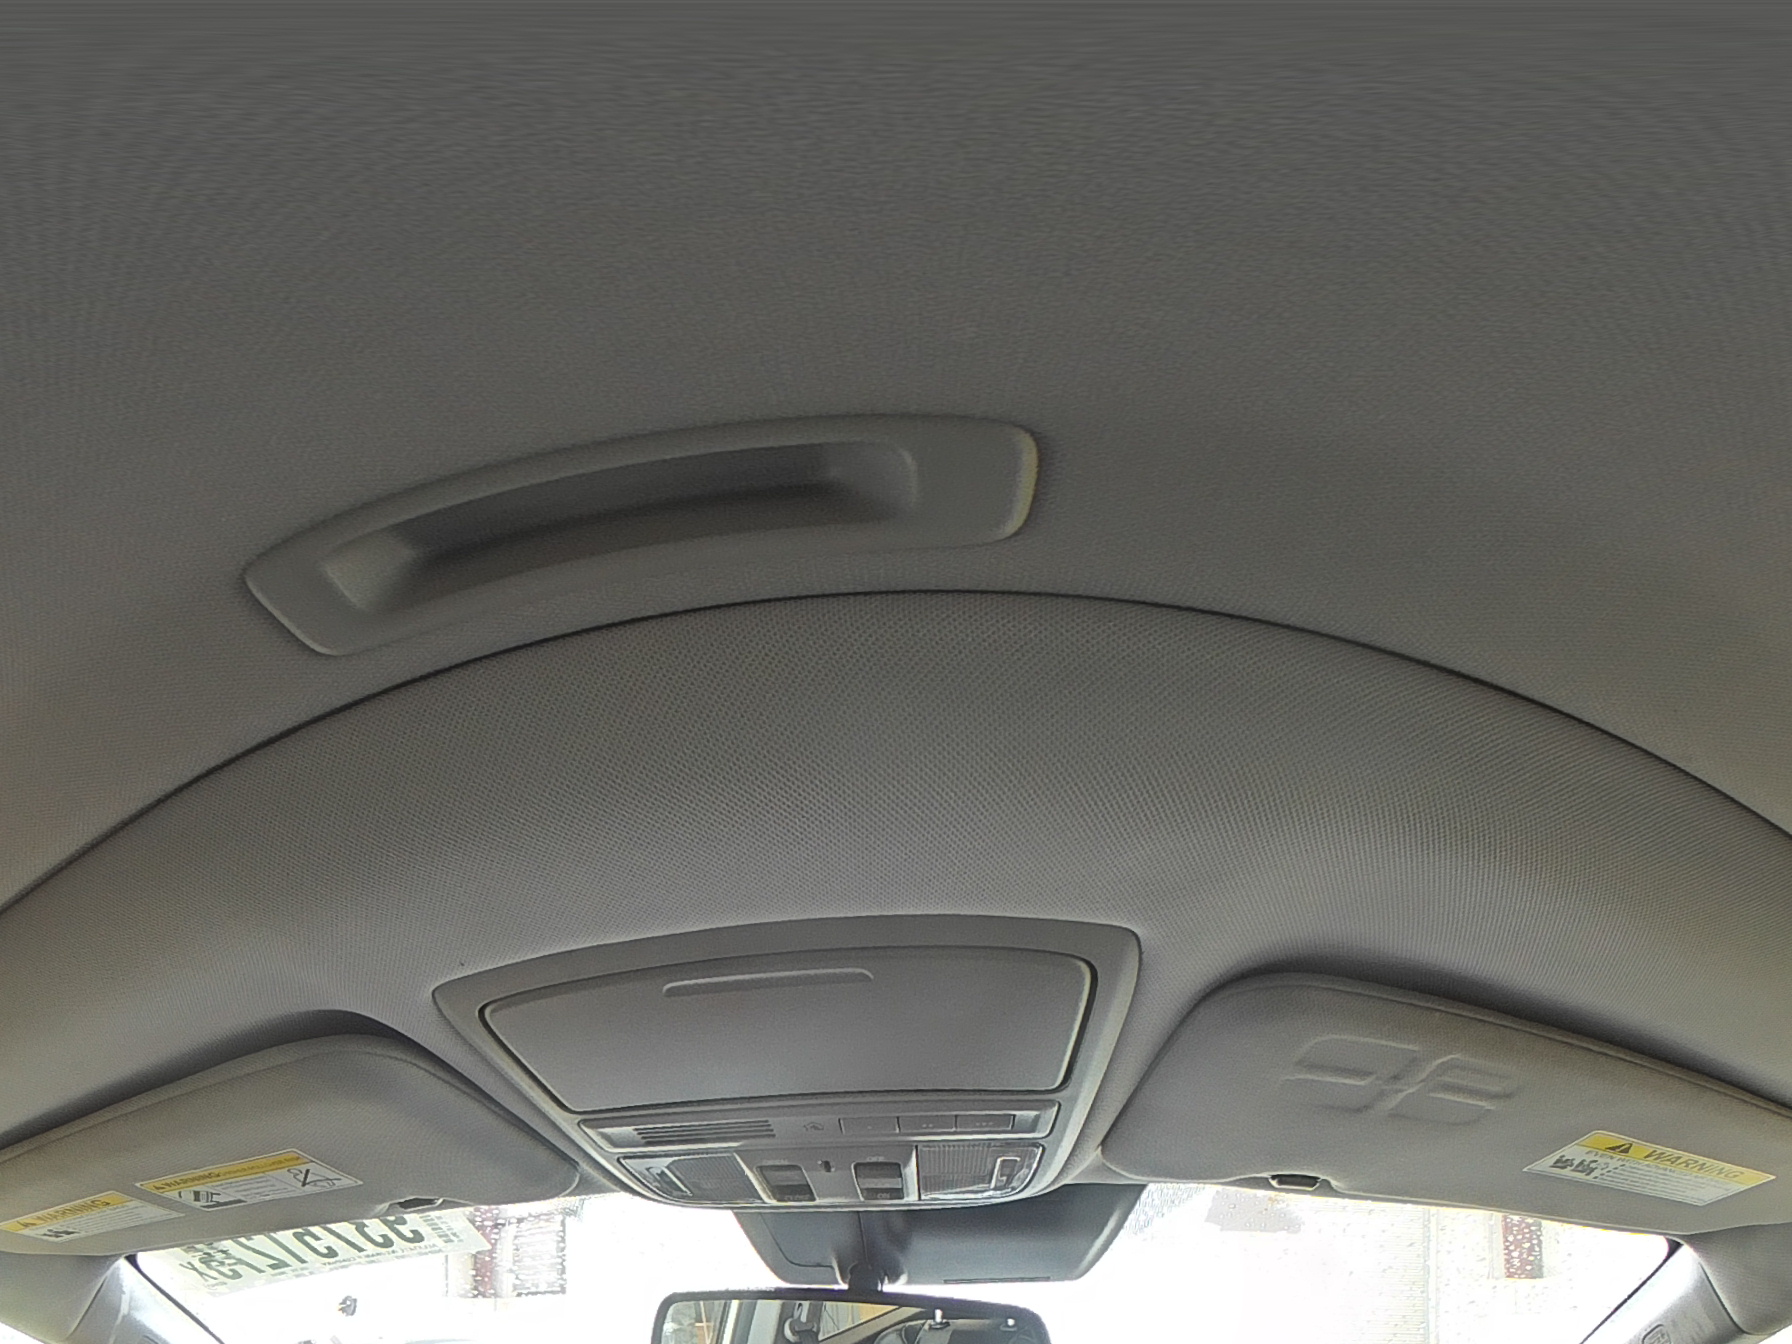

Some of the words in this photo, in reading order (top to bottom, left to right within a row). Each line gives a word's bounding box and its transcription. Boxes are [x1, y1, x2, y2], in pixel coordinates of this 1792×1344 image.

[1644, 1149, 1746, 1180] WARNING
[165, 1171, 221, 1190] WARNING
[38, 1199, 111, 1224] WARNING
